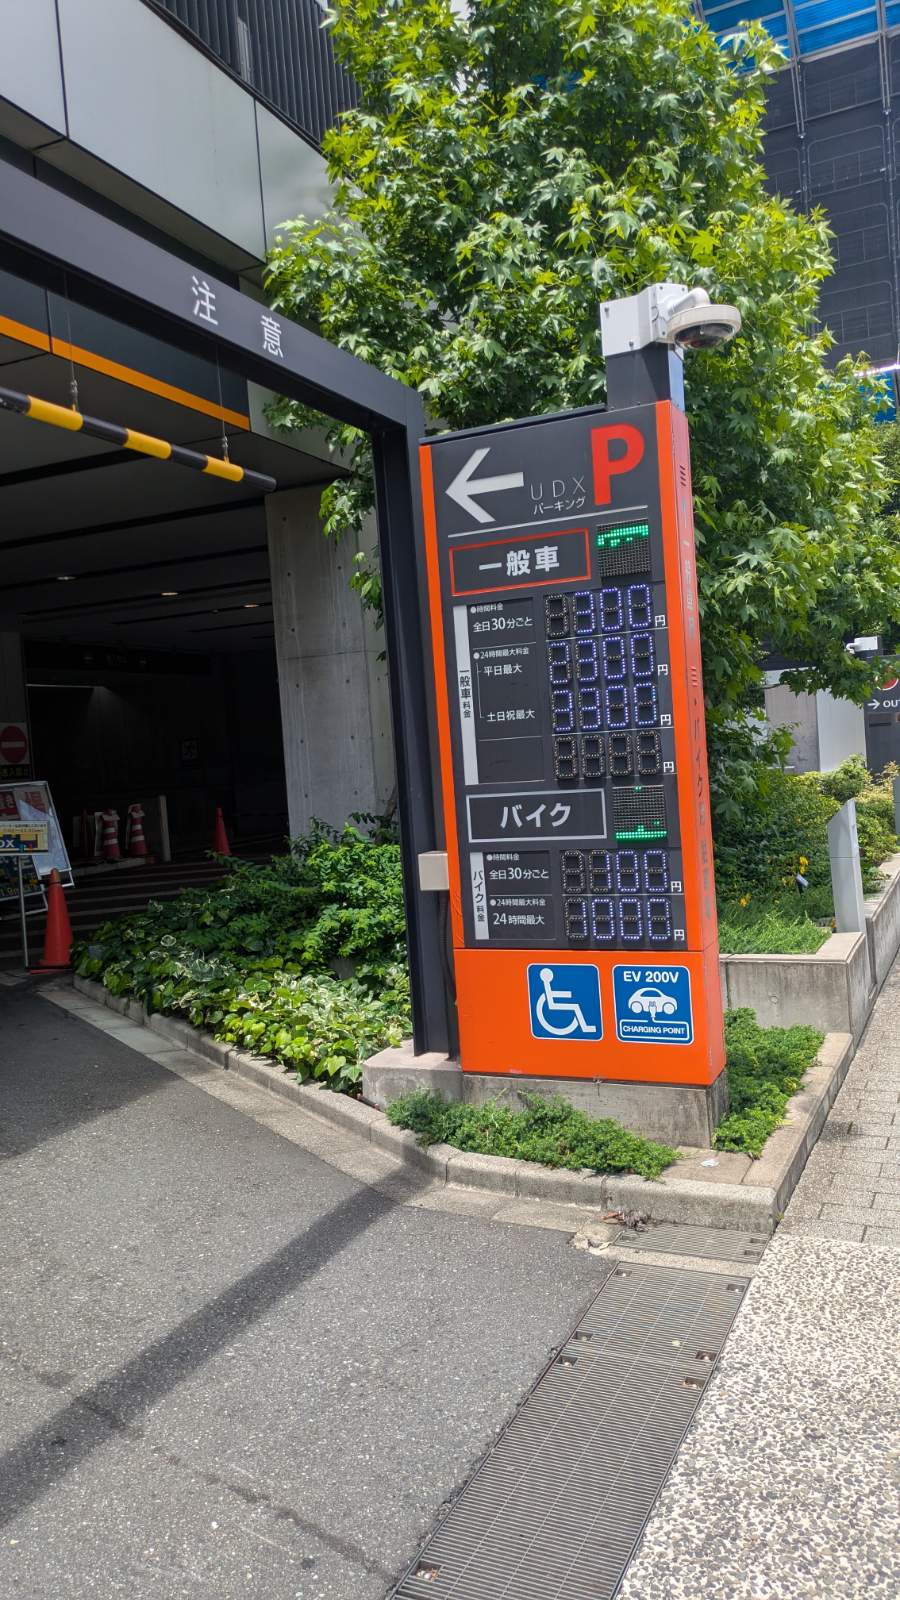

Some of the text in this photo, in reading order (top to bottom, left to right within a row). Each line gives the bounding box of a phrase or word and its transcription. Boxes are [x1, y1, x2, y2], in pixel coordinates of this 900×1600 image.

[191, 275, 284, 358] 注意
[591, 423, 645, 506] P
[530, 475, 586, 501] UDX
[533, 496, 586, 516] パーキング
[478, 545, 560, 577] 一般車
[473, 616, 534, 633] 全日30分ごと
[483, 664, 523, 677] 平日最大
[486, 708, 536, 723] 土日祝最大
[663, 761, 675, 773] 円
[500, 803, 571, 829] バイク
[489, 868, 550, 881] 全日30分ごと
[492, 912, 545, 926] 24時間最大
[623, 971, 679, 984] EV 200V
[622, 1024, 686, 1036] CHARGING POINT
